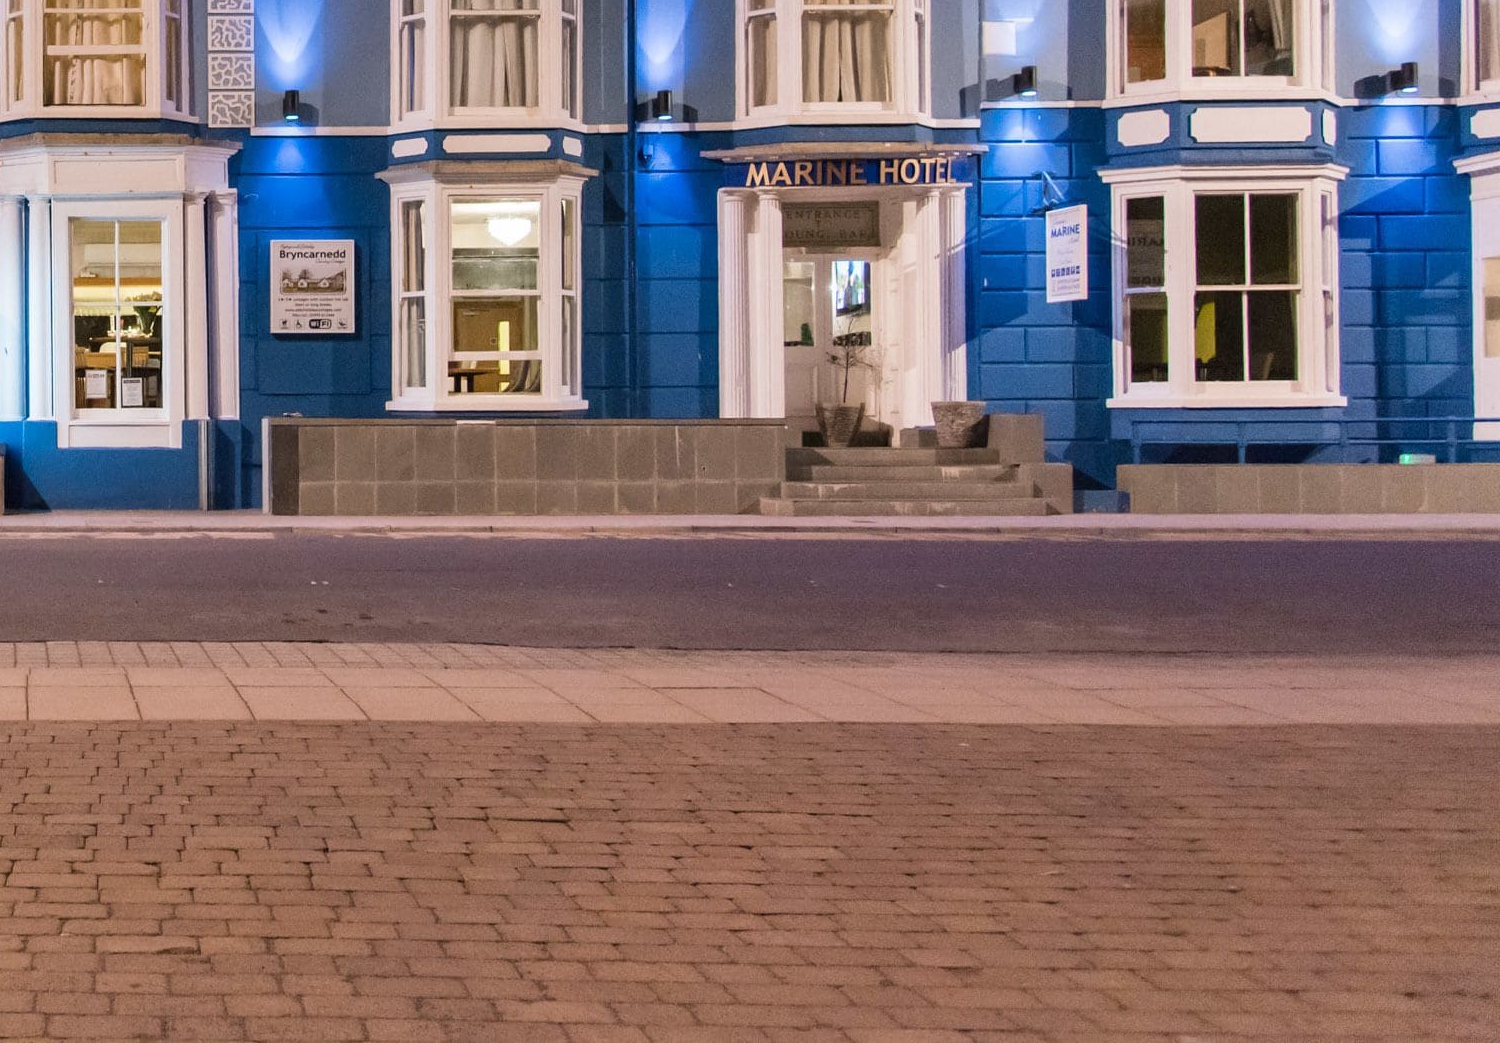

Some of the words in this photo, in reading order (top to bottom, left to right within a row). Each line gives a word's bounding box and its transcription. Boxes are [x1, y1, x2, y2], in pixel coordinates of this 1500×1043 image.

[745, 159, 868, 187] MARINE
[879, 156, 957, 184] HOTEL
[1050, 223, 1081, 239] MARINE
[279, 249, 346, 261] Bryncarnedd
